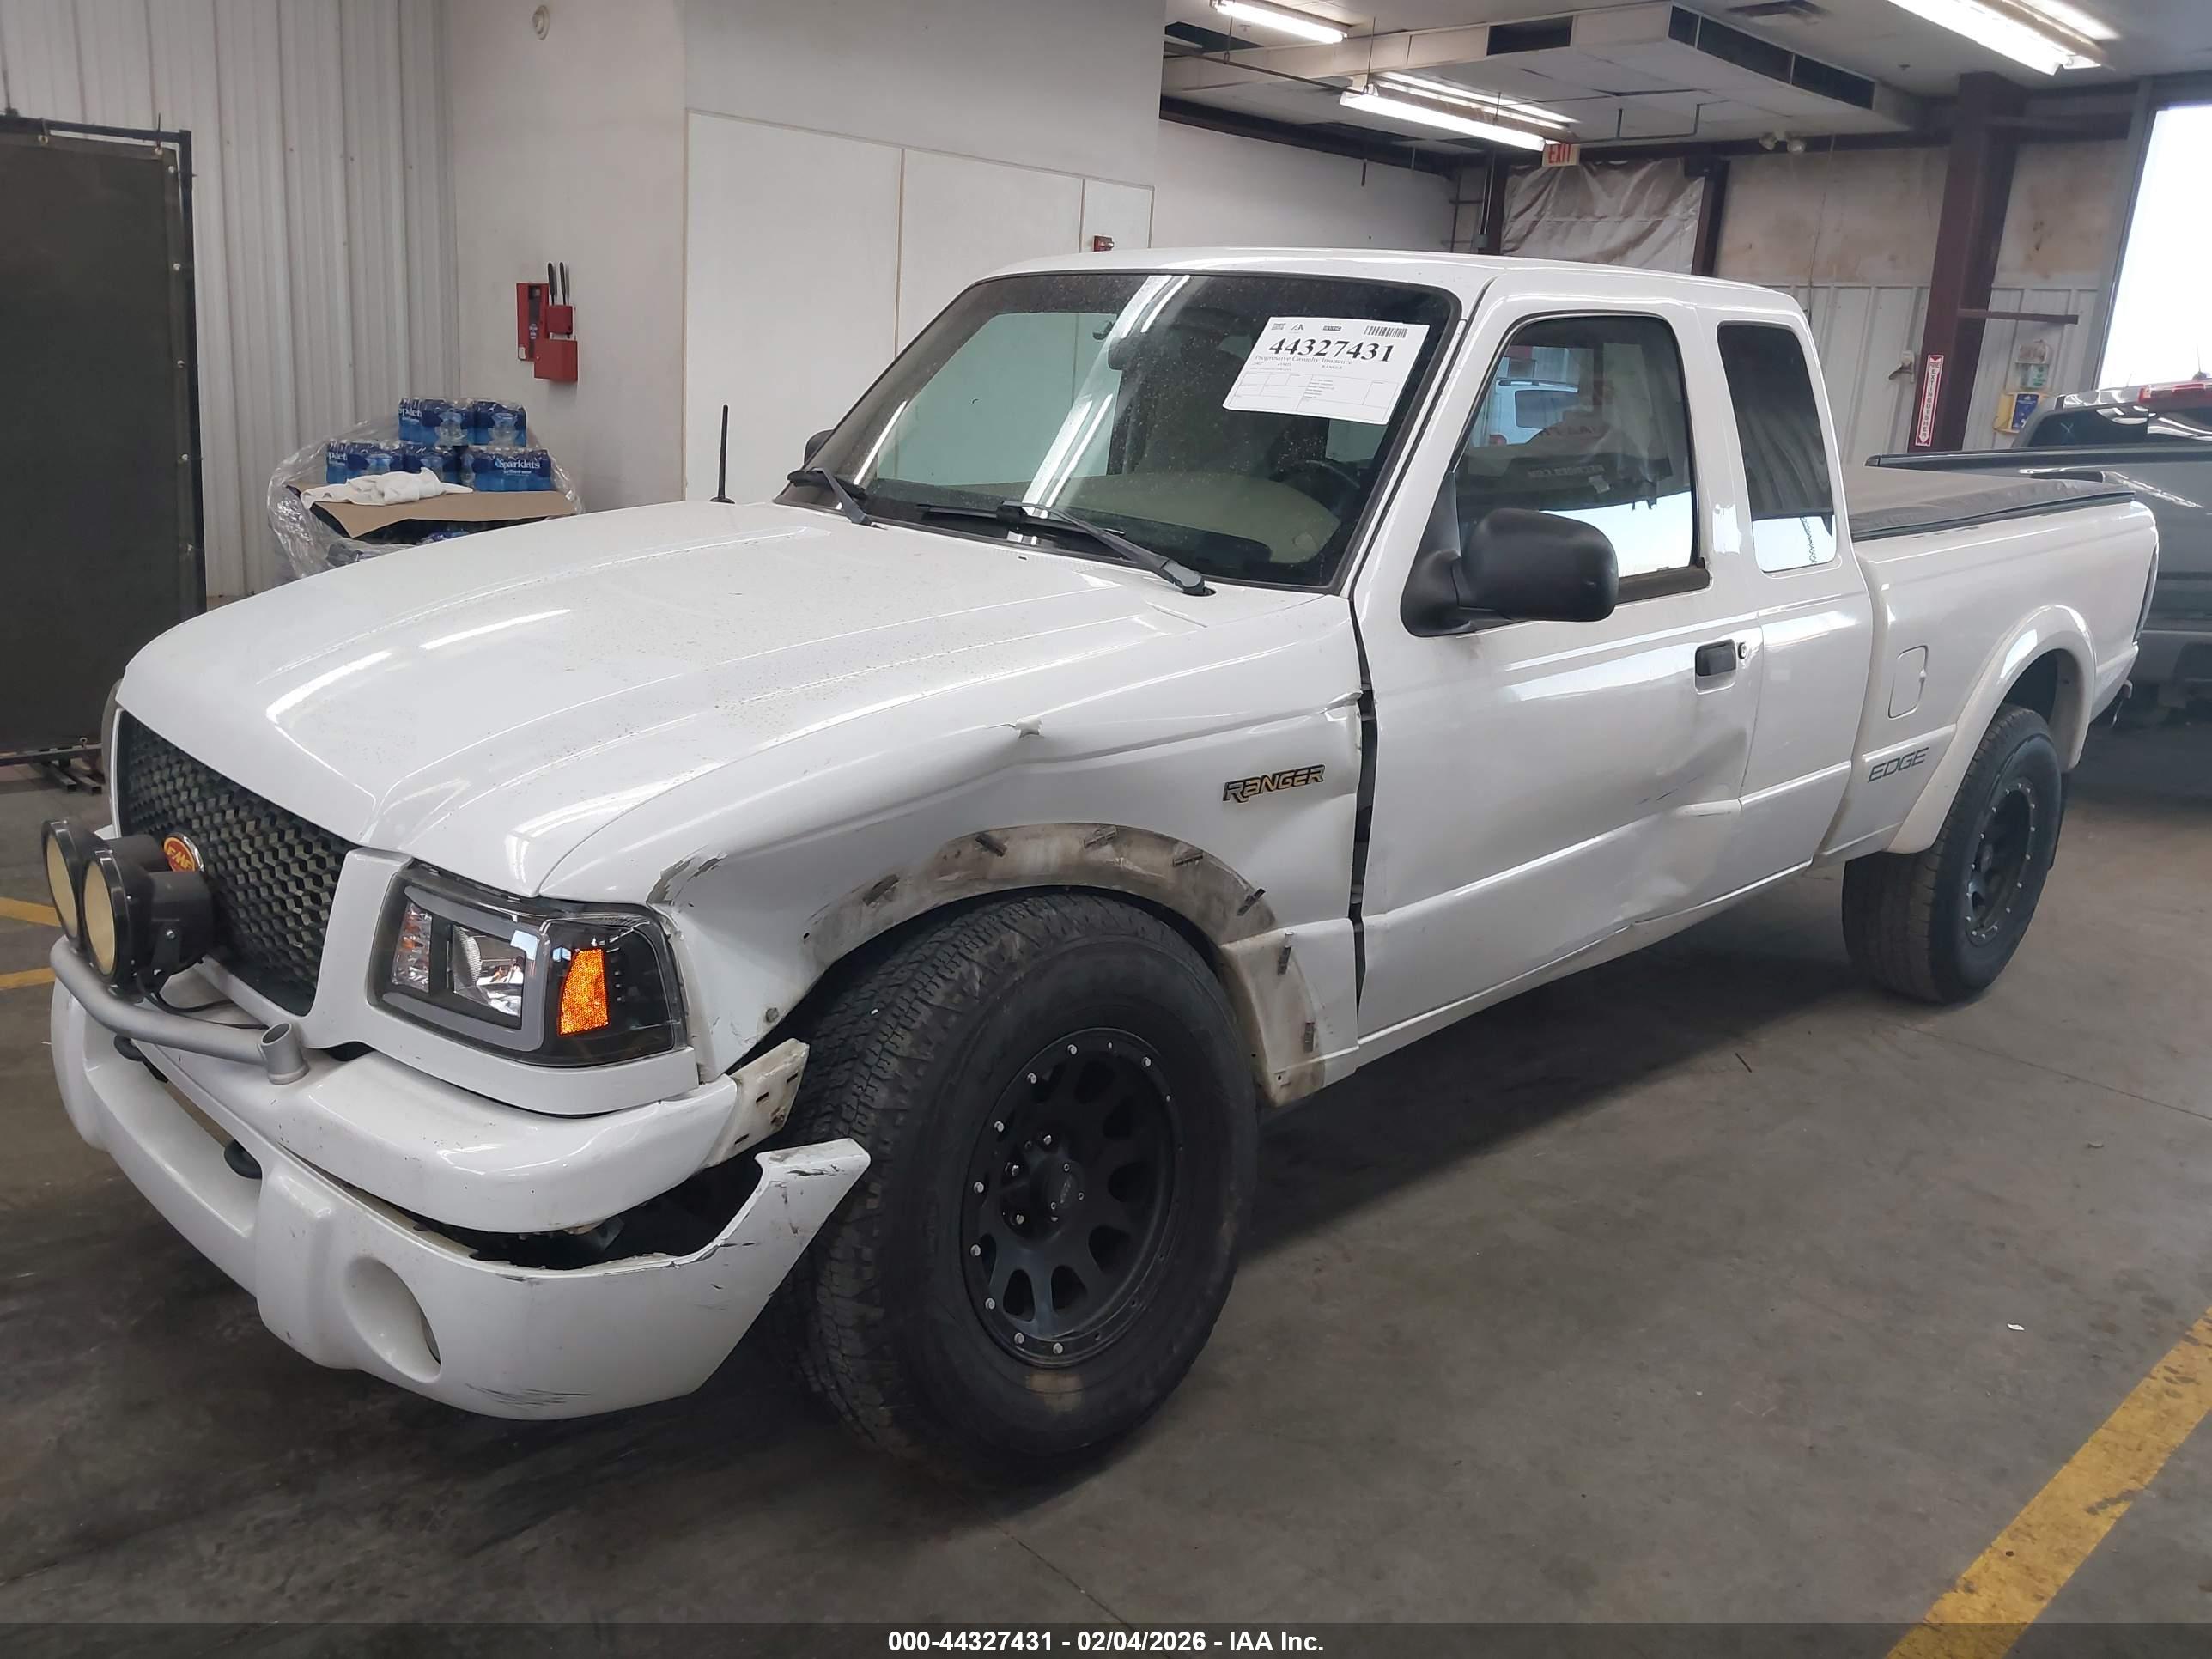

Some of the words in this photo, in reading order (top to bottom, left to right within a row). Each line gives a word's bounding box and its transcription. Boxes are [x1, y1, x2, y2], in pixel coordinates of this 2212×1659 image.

[1268, 337, 1395, 362] 44327431
[1922, 369, 1936, 438] EXTINGUISHER
[1222, 763, 1326, 804] RANGER
[1868, 746, 1930, 783] EDGE
